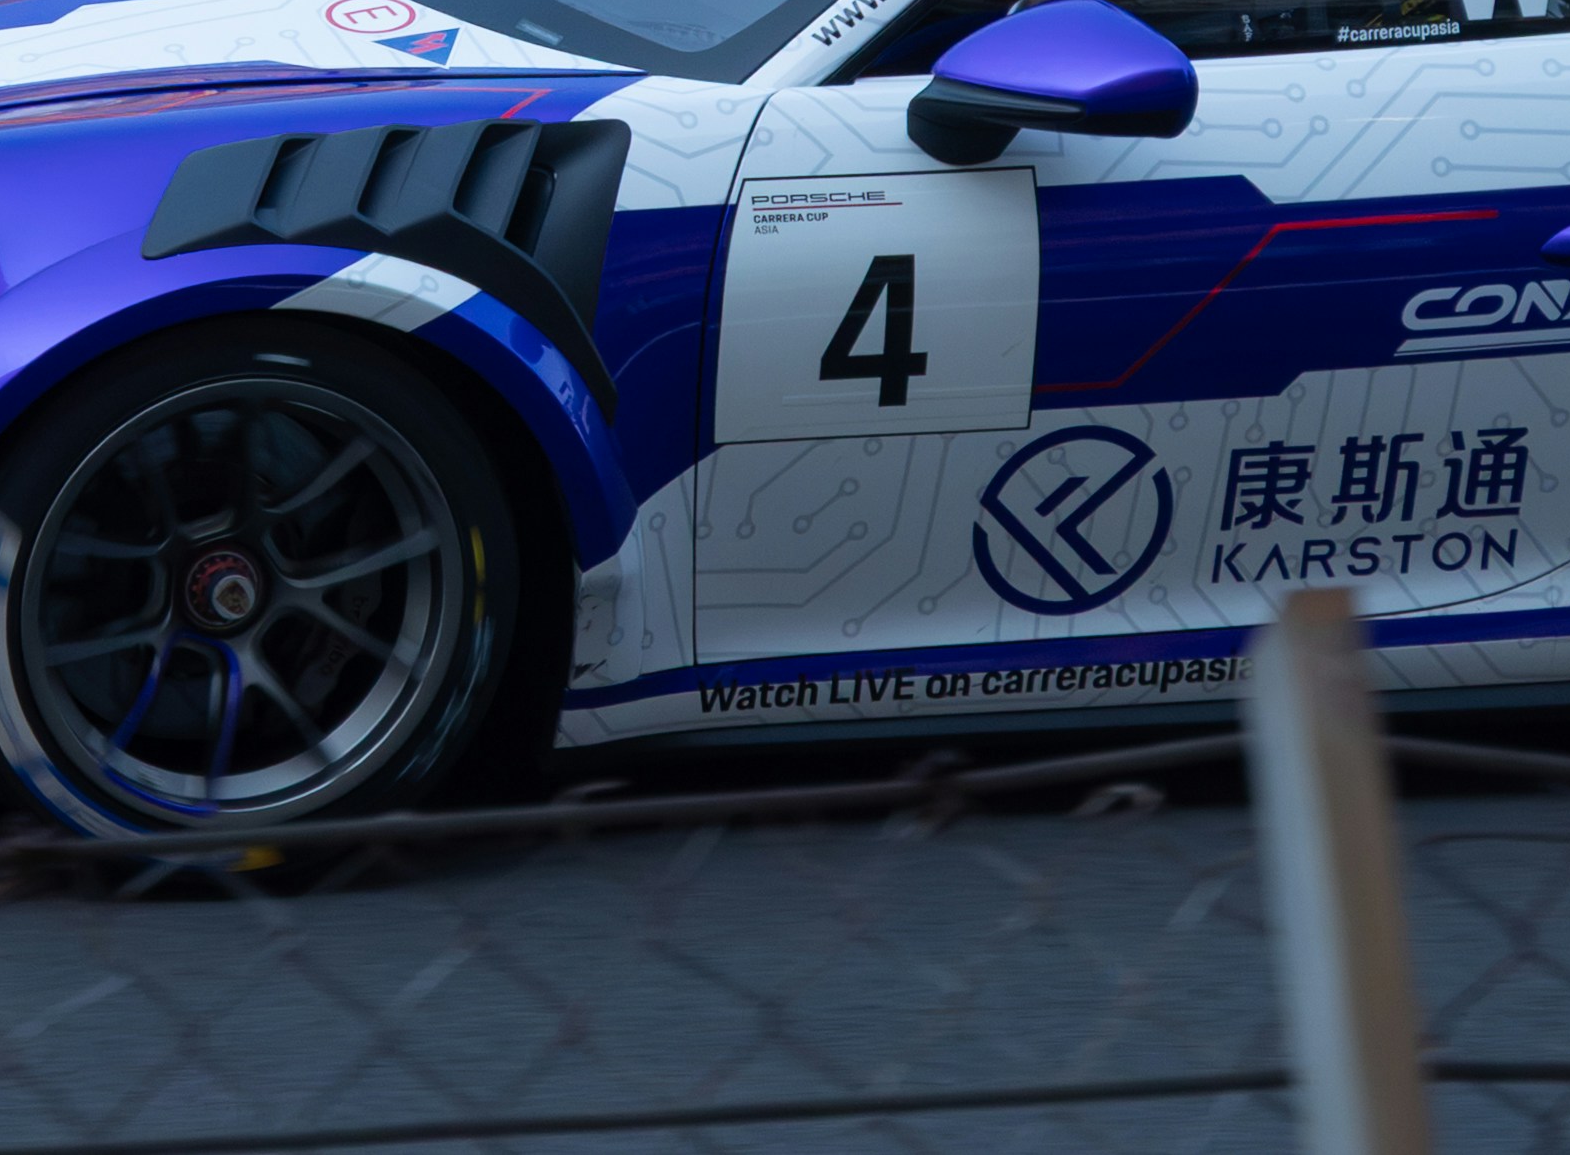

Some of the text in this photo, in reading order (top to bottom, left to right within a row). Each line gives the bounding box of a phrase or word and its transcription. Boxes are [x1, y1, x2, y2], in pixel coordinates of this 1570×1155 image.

[1337, 18, 1460, 43] #carreracupasia
[751, 191, 885, 205] PORSCHE
[753, 213, 829, 224] CARRERA CUP
[754, 226, 779, 235] ASIA
[819, 253, 928, 407] 4
[1220, 427, 1529, 531] 康斯通
[1211, 528, 1519, 584] KARSTON
[697, 673, 818, 714] Watch
[829, 665, 916, 705] LIVE
[924, 669, 972, 701] on
